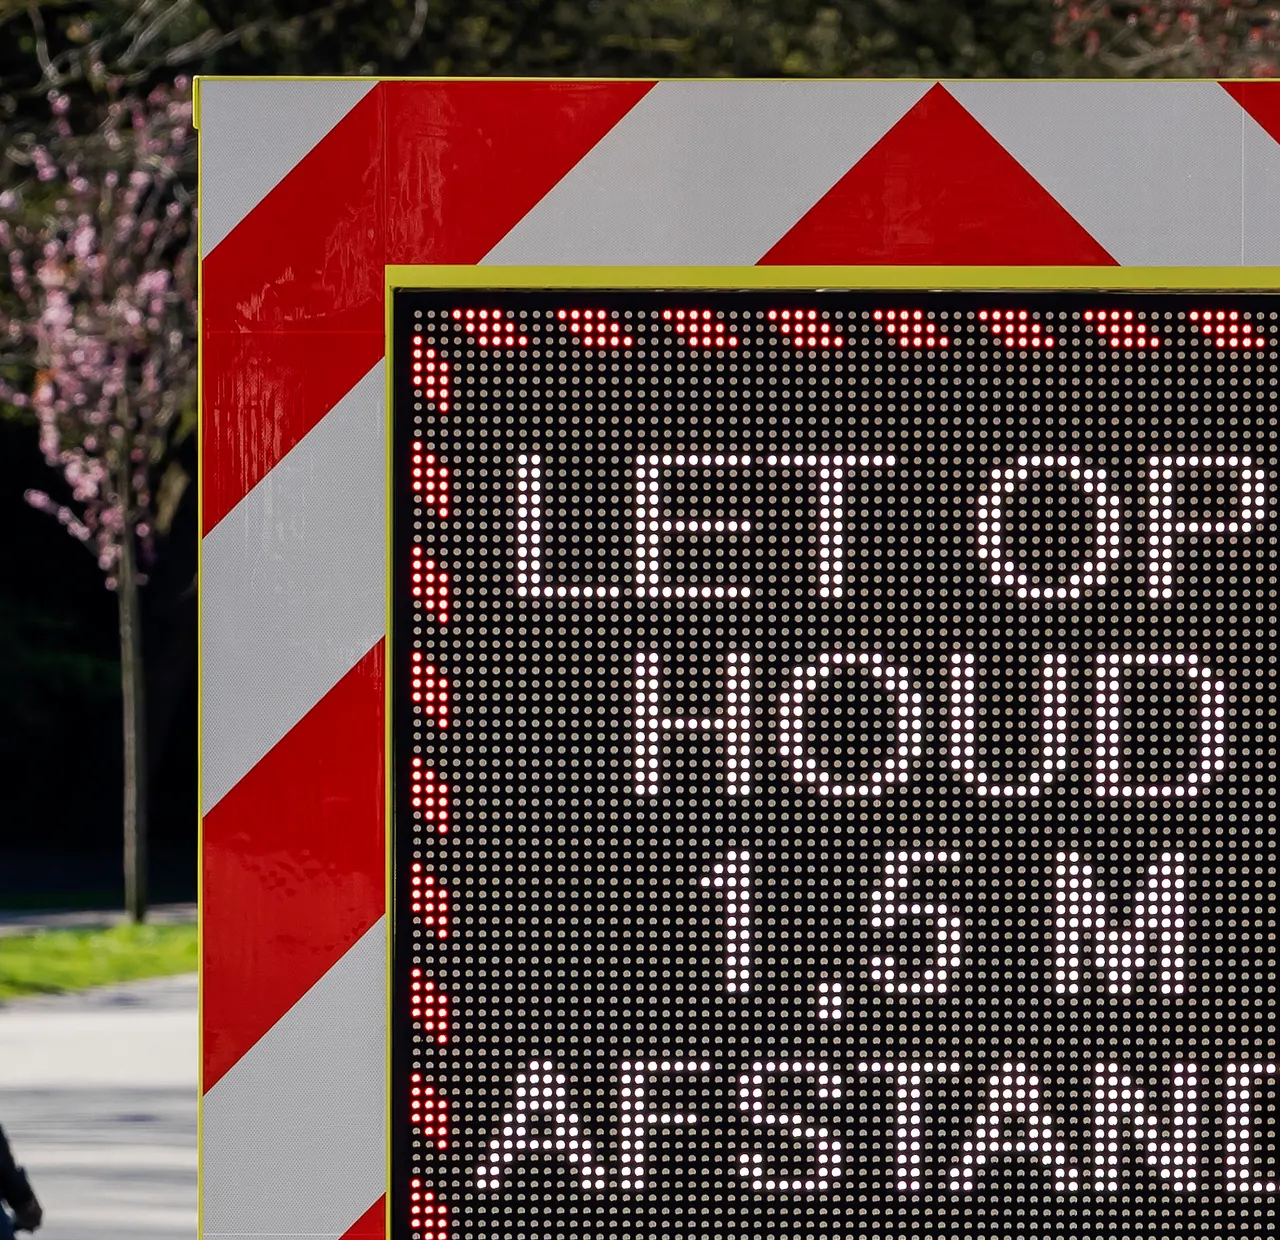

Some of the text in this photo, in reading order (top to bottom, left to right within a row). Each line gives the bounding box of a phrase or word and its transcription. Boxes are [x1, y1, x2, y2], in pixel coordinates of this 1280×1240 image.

[518, 455, 897, 599] LET
[636, 653, 1226, 798] HOUD
[702, 851, 1186, 1020] 1,5 M
